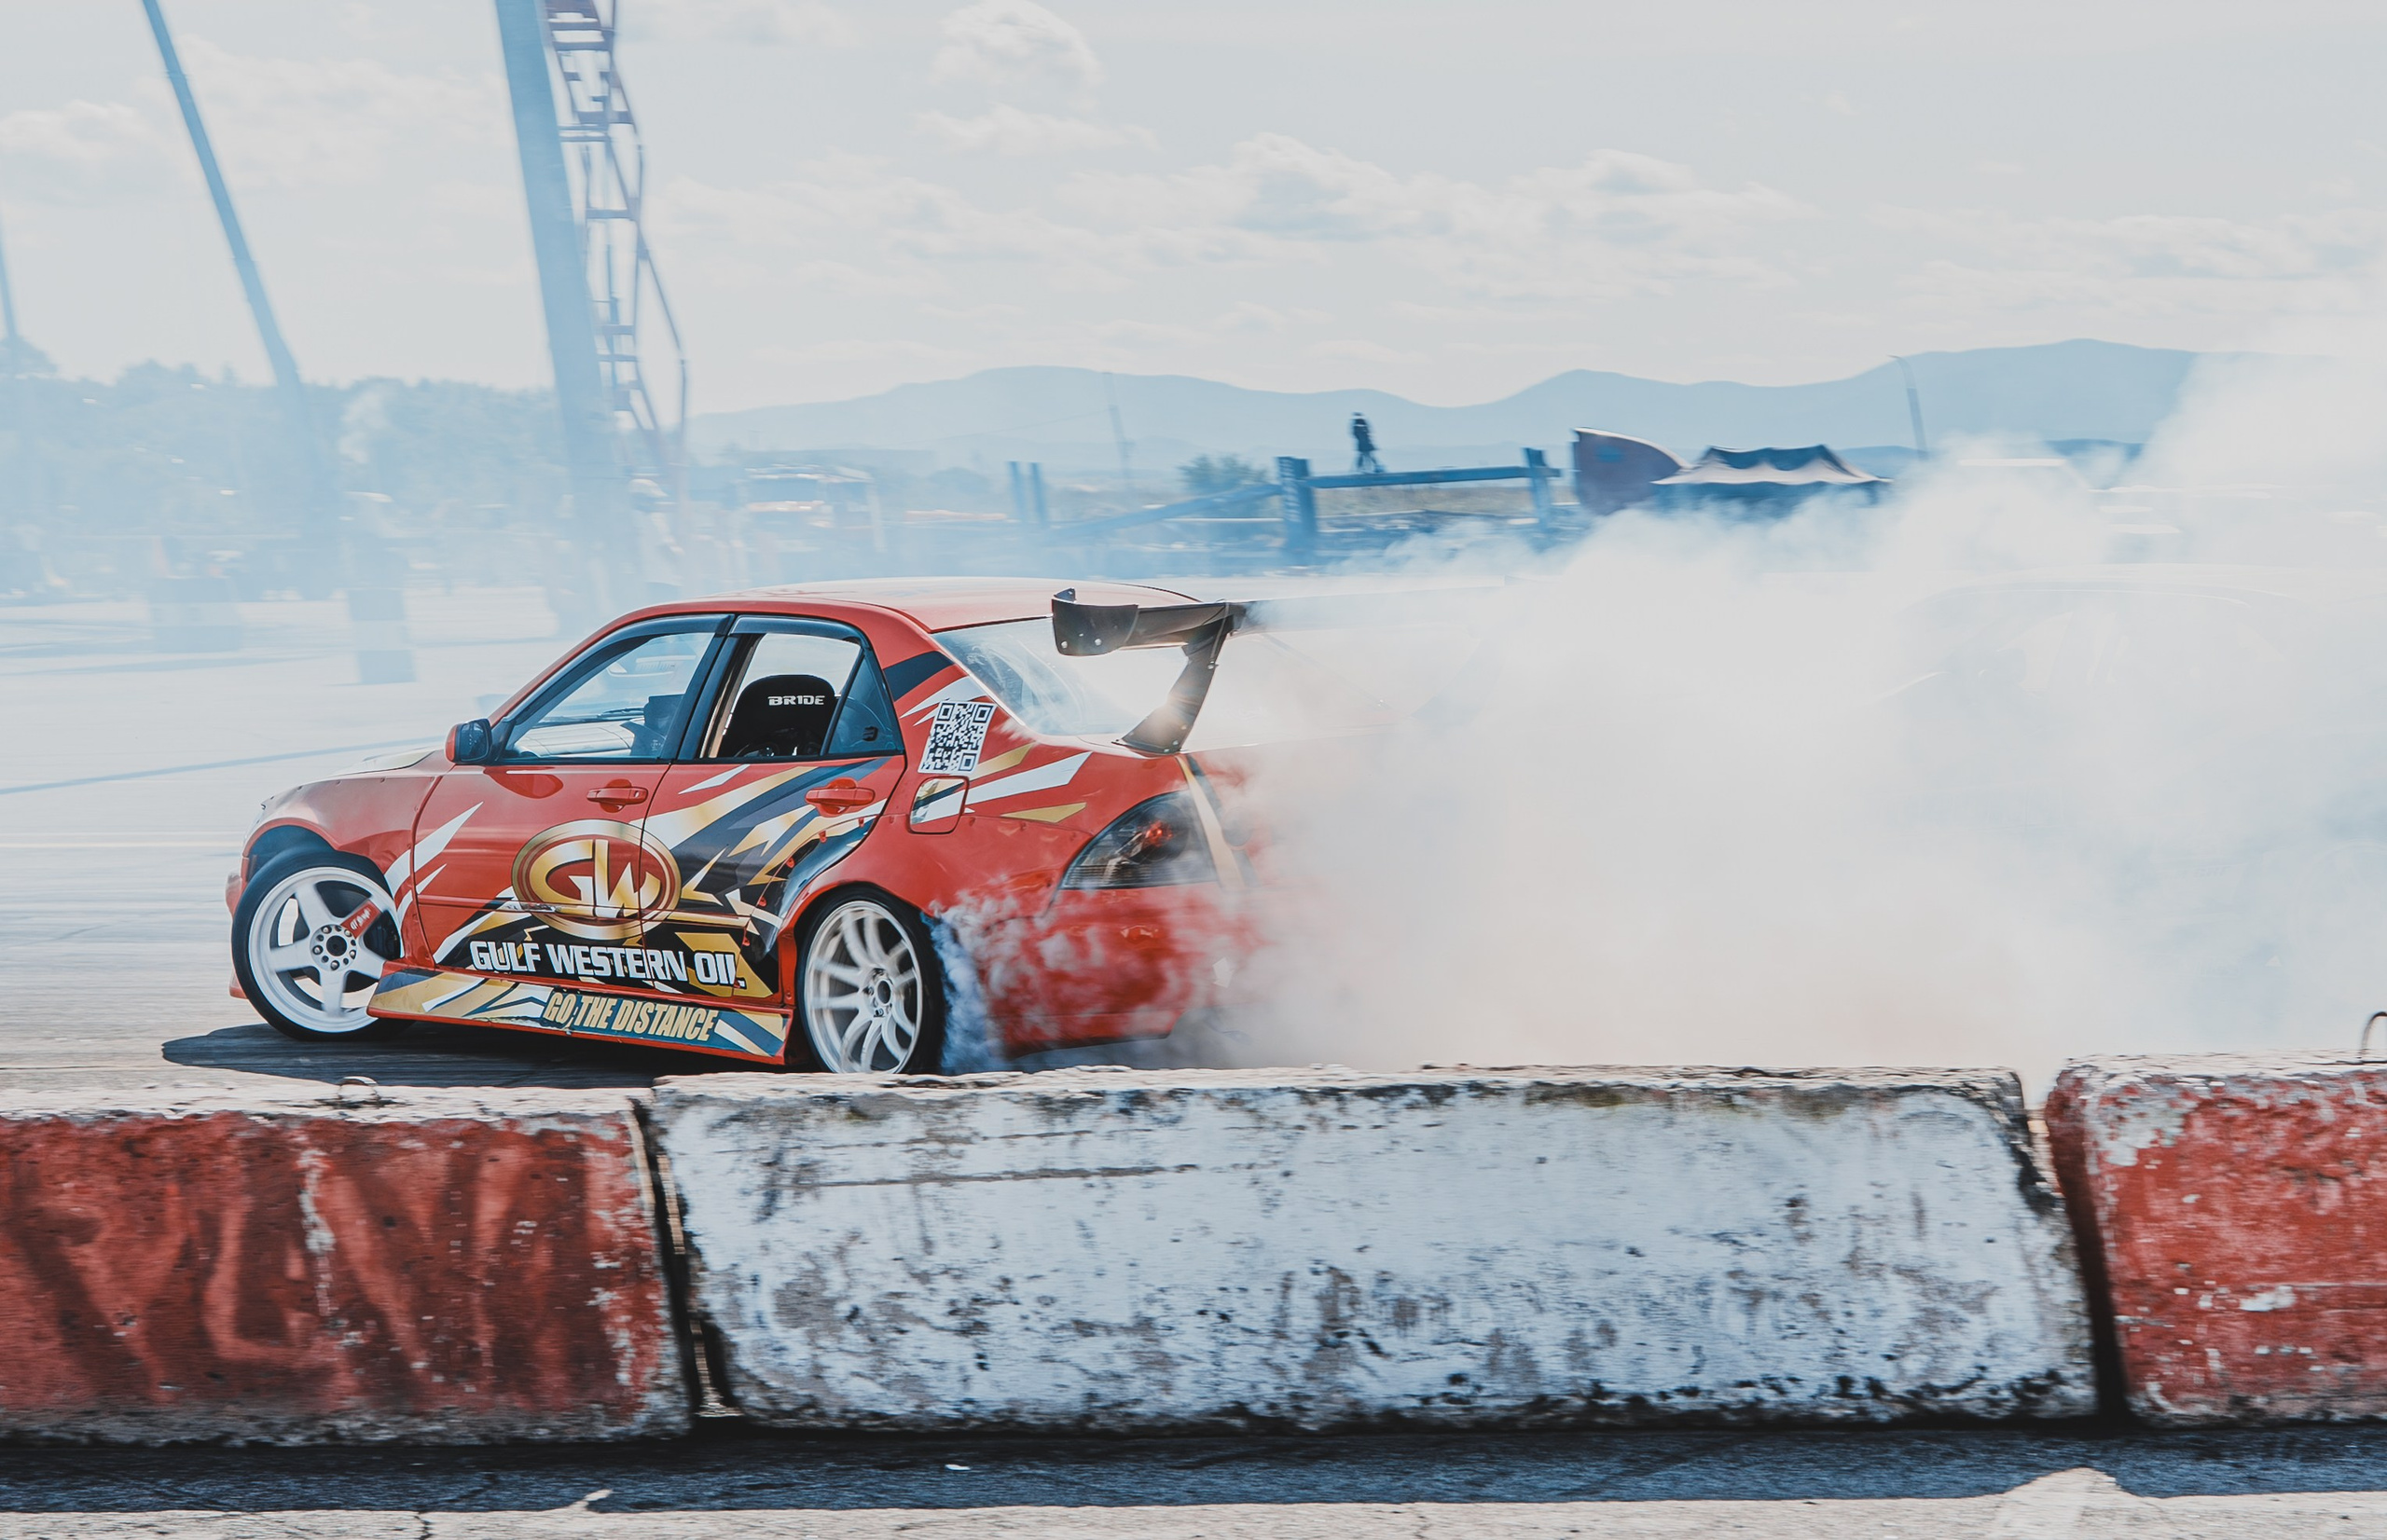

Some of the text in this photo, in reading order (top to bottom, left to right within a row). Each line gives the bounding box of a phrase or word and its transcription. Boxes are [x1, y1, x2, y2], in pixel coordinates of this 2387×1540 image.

[767, 694, 826, 706] BRIDE
[529, 839, 661, 918] GW
[469, 941, 746, 987] GULF WESTERN OIL
[543, 992, 720, 1041] GO THE DISTANCE
